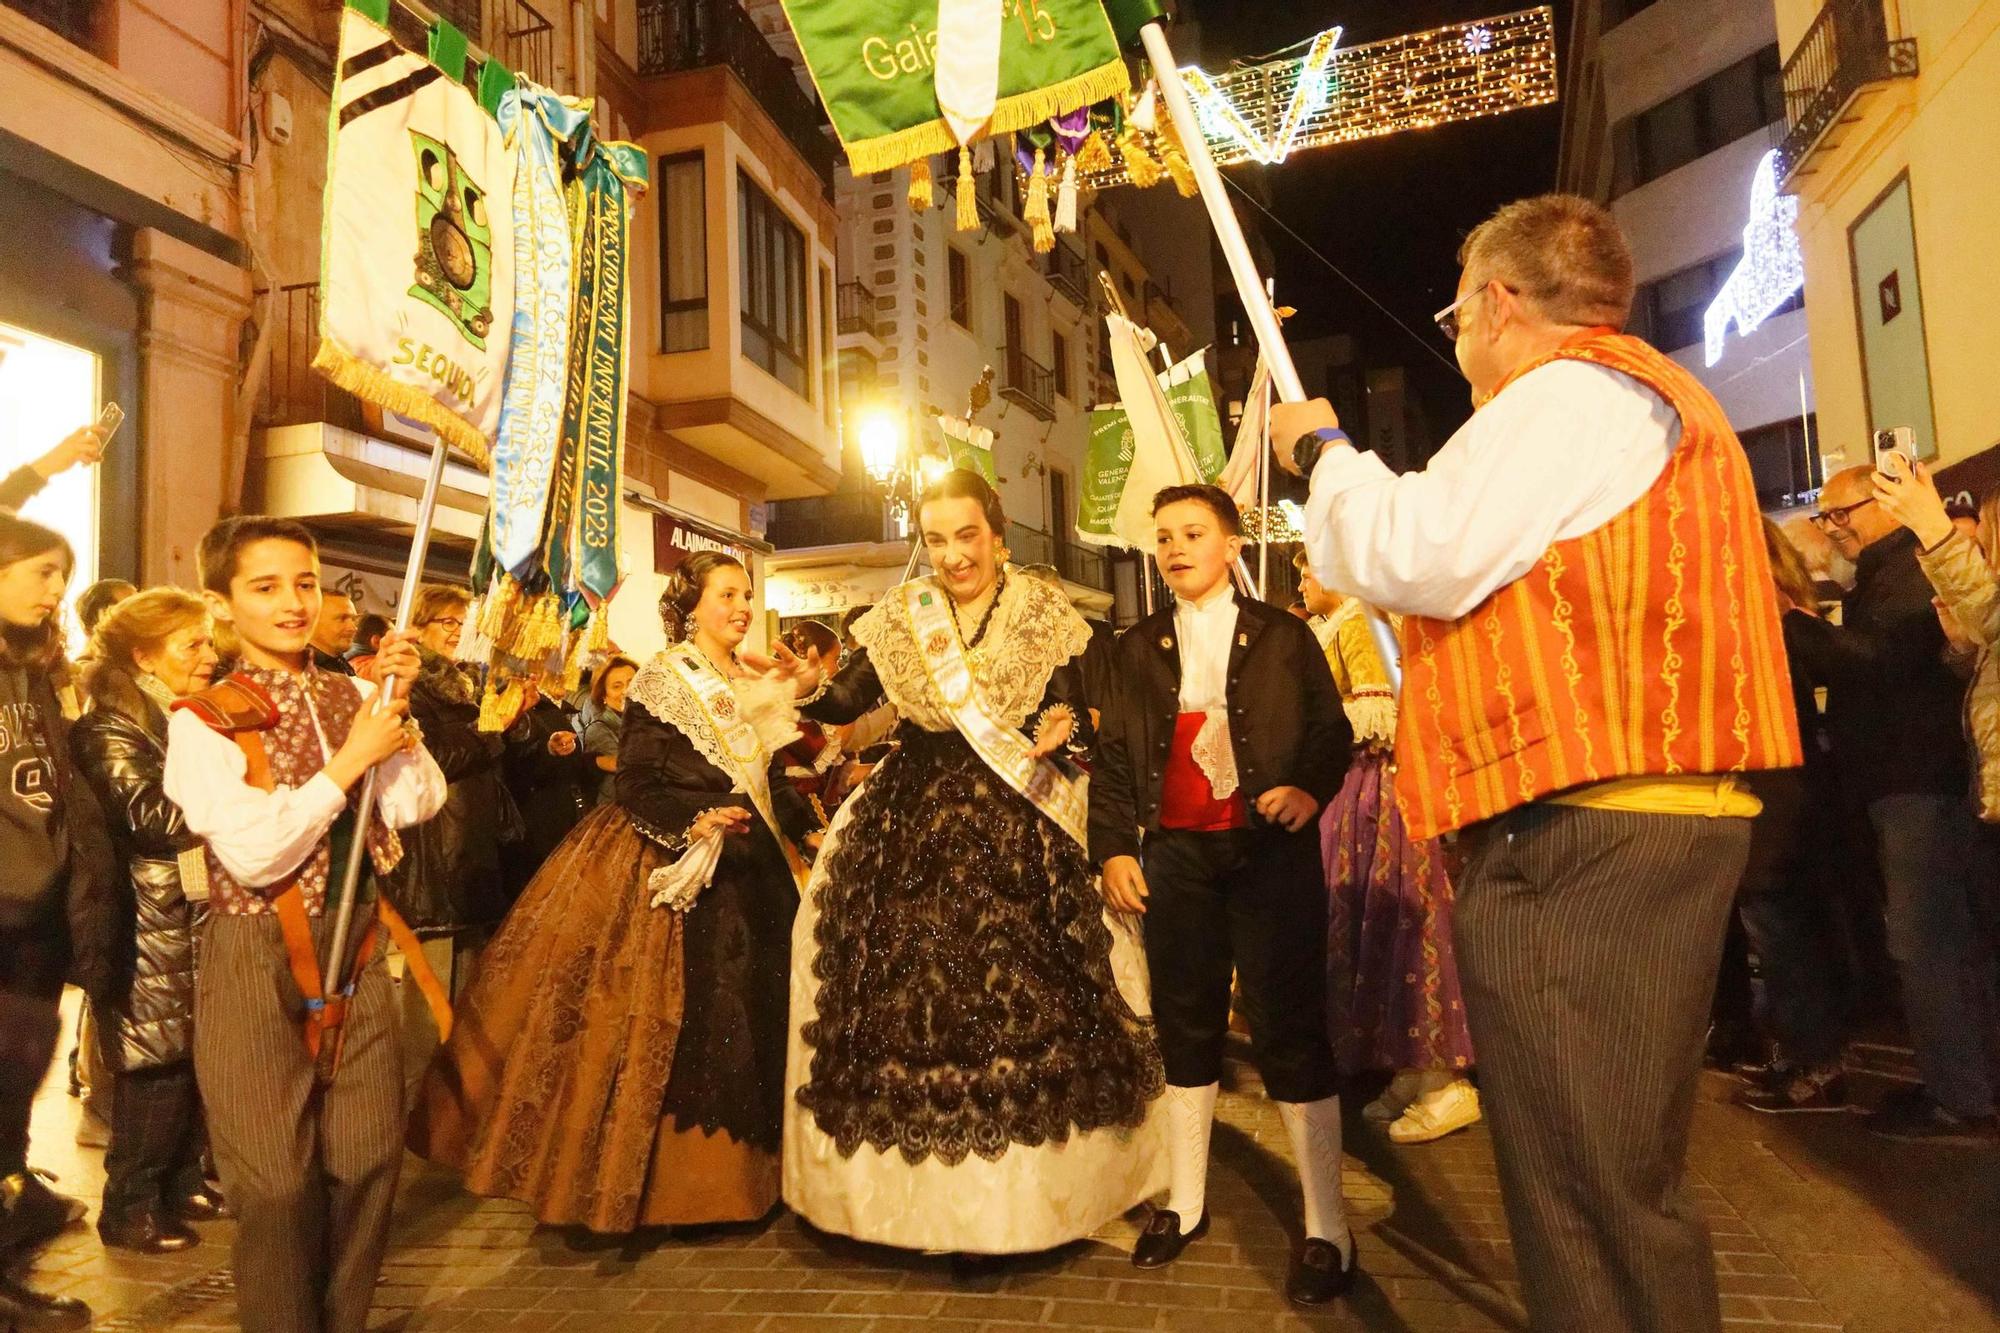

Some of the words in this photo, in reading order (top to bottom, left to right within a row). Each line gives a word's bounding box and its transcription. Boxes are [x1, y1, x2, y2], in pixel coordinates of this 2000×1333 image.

[598, 193, 620, 351] PRESIDENT
[587, 347, 615, 472] INFANTIL
[1098, 467, 1130, 478] GENERA
[1098, 474, 1128, 485] VALENC
[584, 480, 609, 549] 2023
